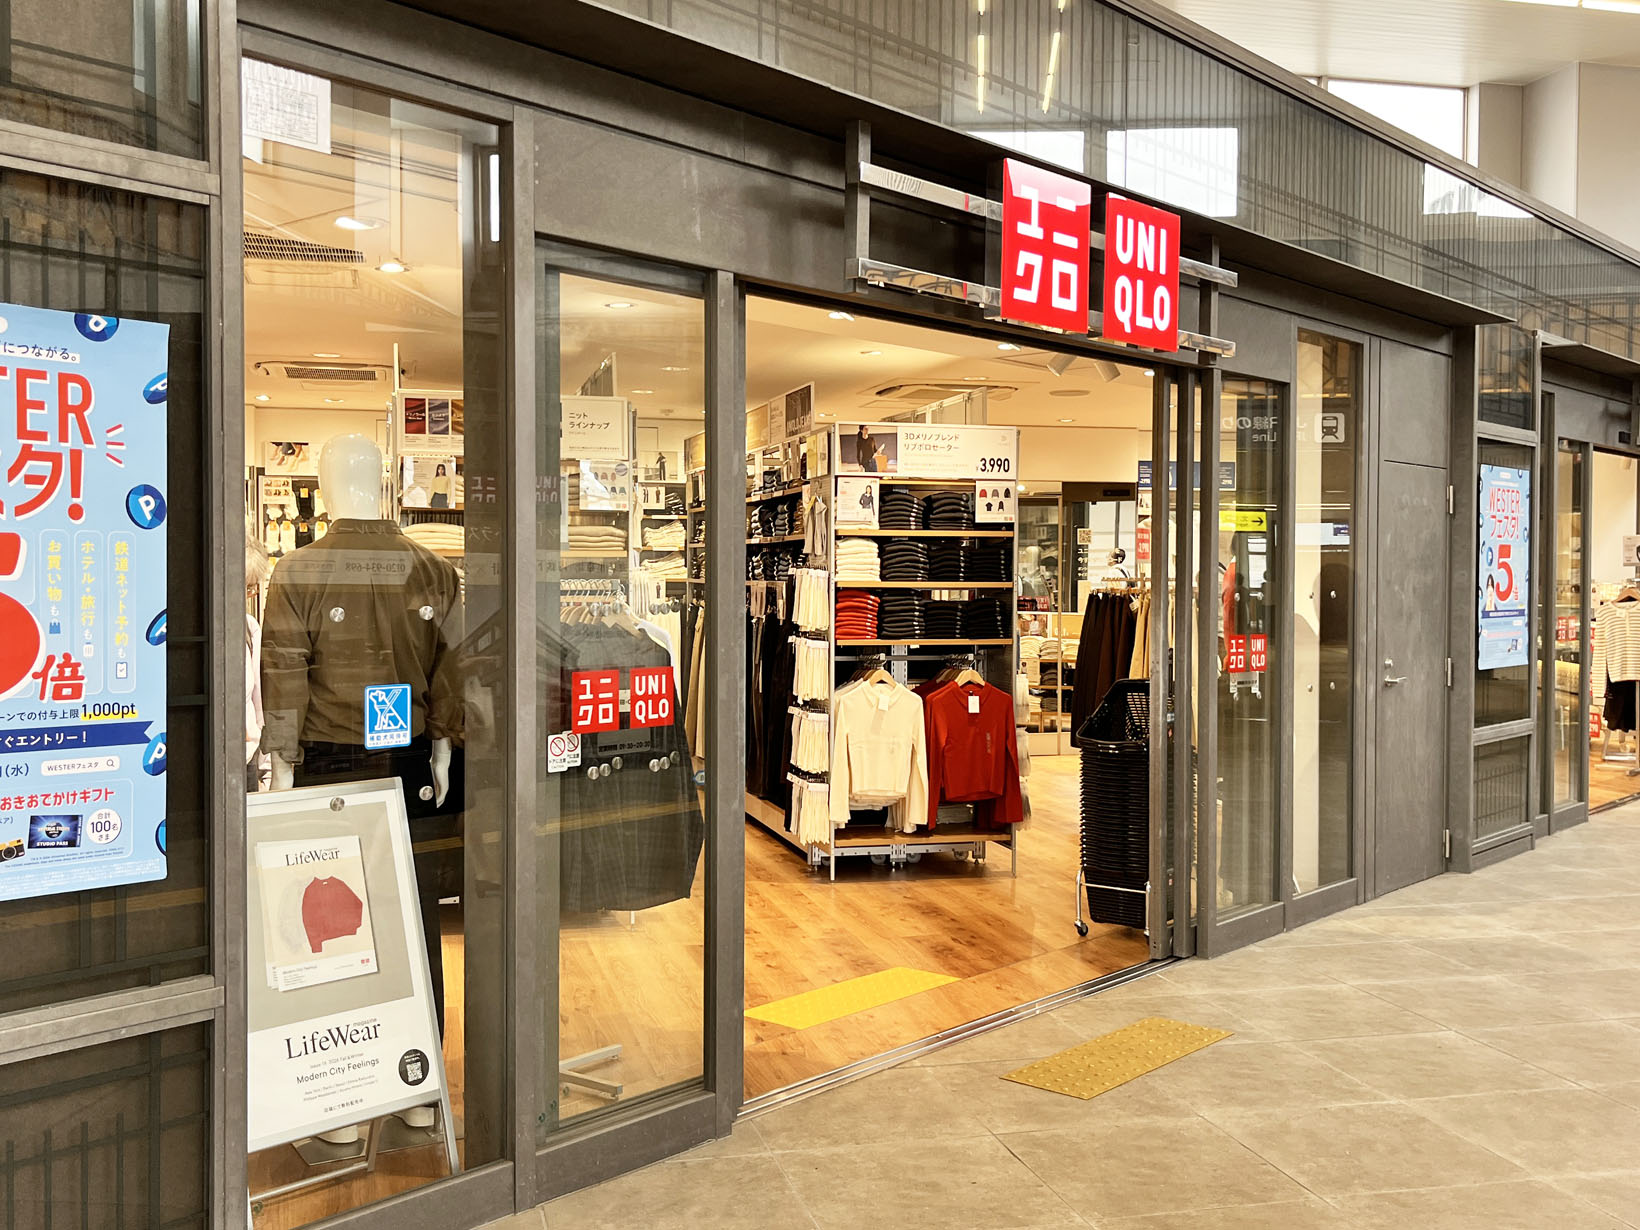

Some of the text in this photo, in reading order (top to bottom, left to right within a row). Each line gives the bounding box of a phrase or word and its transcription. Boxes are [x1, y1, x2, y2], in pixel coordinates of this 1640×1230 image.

[1016, 184, 1079, 250] ユニ
[1116, 214, 1167, 276] UNI
[1013, 250, 1078, 313] クロ
[1114, 275, 1171, 333] QLO
[0, 340, 77, 362] につながる。
[0, 366, 94, 446] ER
[568, 421, 611, 430] ラインナップ
[0, 443, 85, 522] タ!
[1489, 488, 1520, 513] WESTER
[47, 540, 63, 617] お買い物も
[80, 541, 96, 641] ホテル・旅行も
[114, 541, 130, 659] 鉄道ネット予約も
[1229, 639, 1244, 653] ユニ
[1251, 638, 1265, 652] UNI
[1229, 655, 1244, 669] クロ
[1251, 654, 1266, 669] QLO
[578, 677, 614, 700] ユニ
[634, 674, 667, 696] UNI
[577, 703, 614, 726] クロ
[634, 698, 670, 724] QLO
[285, 848, 340, 866] LifeWear
[284, 1023, 381, 1060] LifeWear
[296, 1058, 380, 1084] Modern City Feelings
